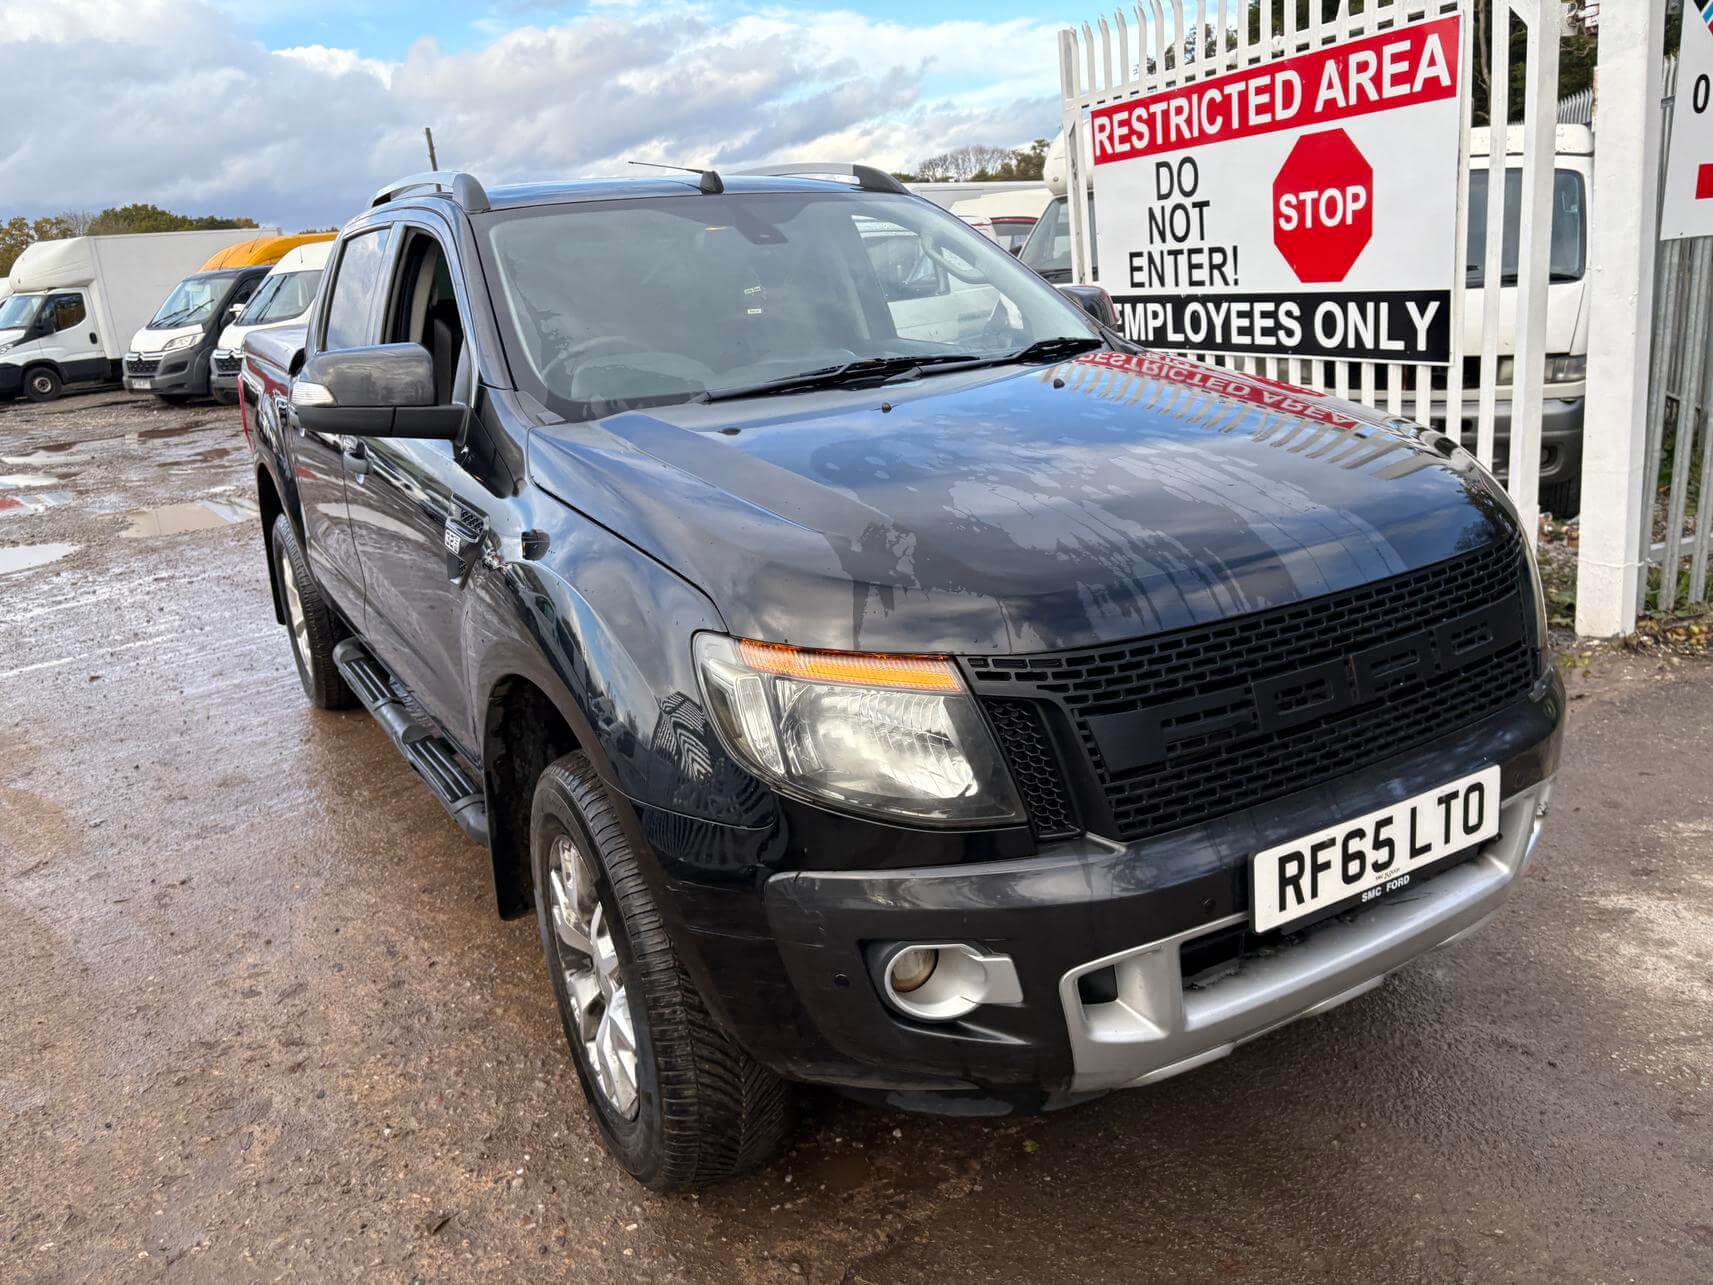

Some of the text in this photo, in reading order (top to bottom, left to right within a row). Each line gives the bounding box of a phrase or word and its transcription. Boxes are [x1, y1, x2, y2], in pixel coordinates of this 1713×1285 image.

[1095, 33, 1451, 156] RESTRICTED AREA
[1693, 74, 1710, 114] 0
[1155, 157, 1199, 201] DO
[1147, 201, 1211, 244] NOT
[1279, 185, 1367, 231] STOP
[1129, 246, 1240, 288] ENTER!
[1314, 300, 1440, 351] ONLY
[1278, 781, 1485, 912] RF65 LTO
[1361, 875, 1410, 903] SMC FORD
